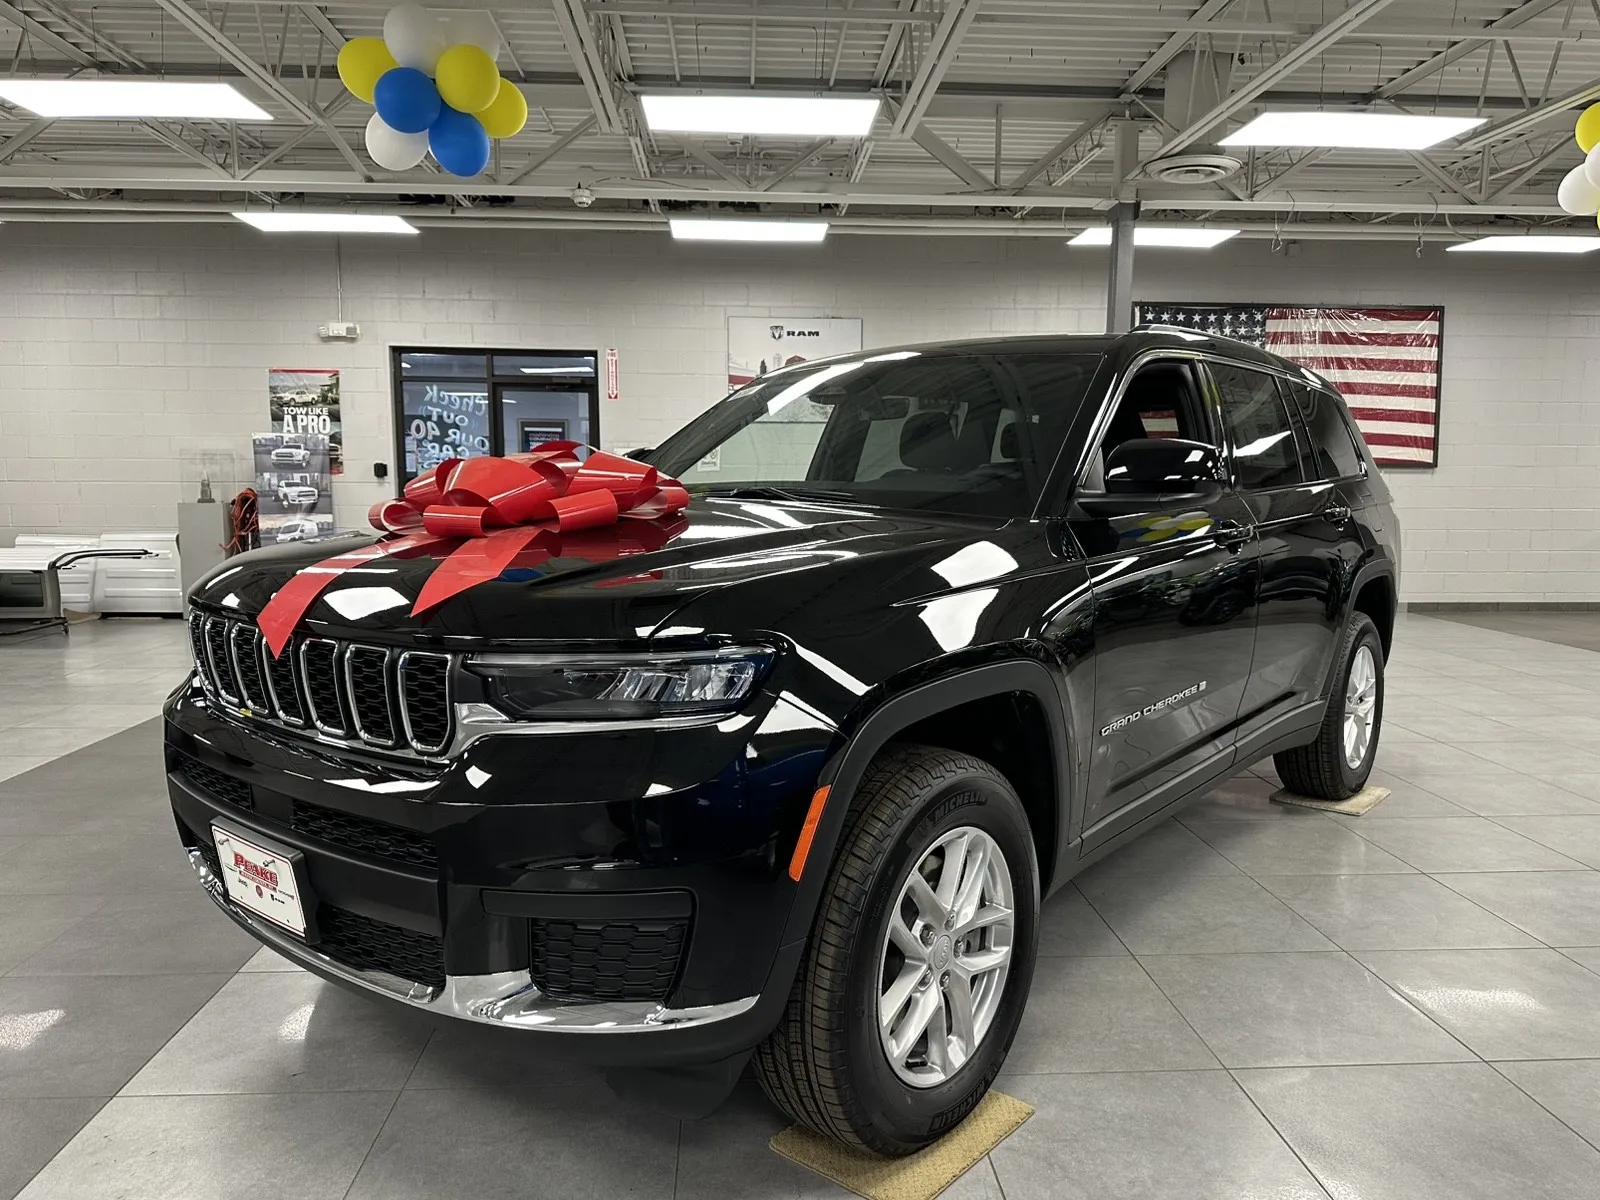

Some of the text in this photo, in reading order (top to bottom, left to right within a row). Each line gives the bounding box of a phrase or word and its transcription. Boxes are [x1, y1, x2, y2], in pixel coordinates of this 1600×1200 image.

[282, 414, 331, 436] A PRO
[283, 407, 329, 415] TOW LIKE
[1101, 684, 1198, 737] GRAND CHEROKEE
[233, 851, 279, 887] PEAKE
